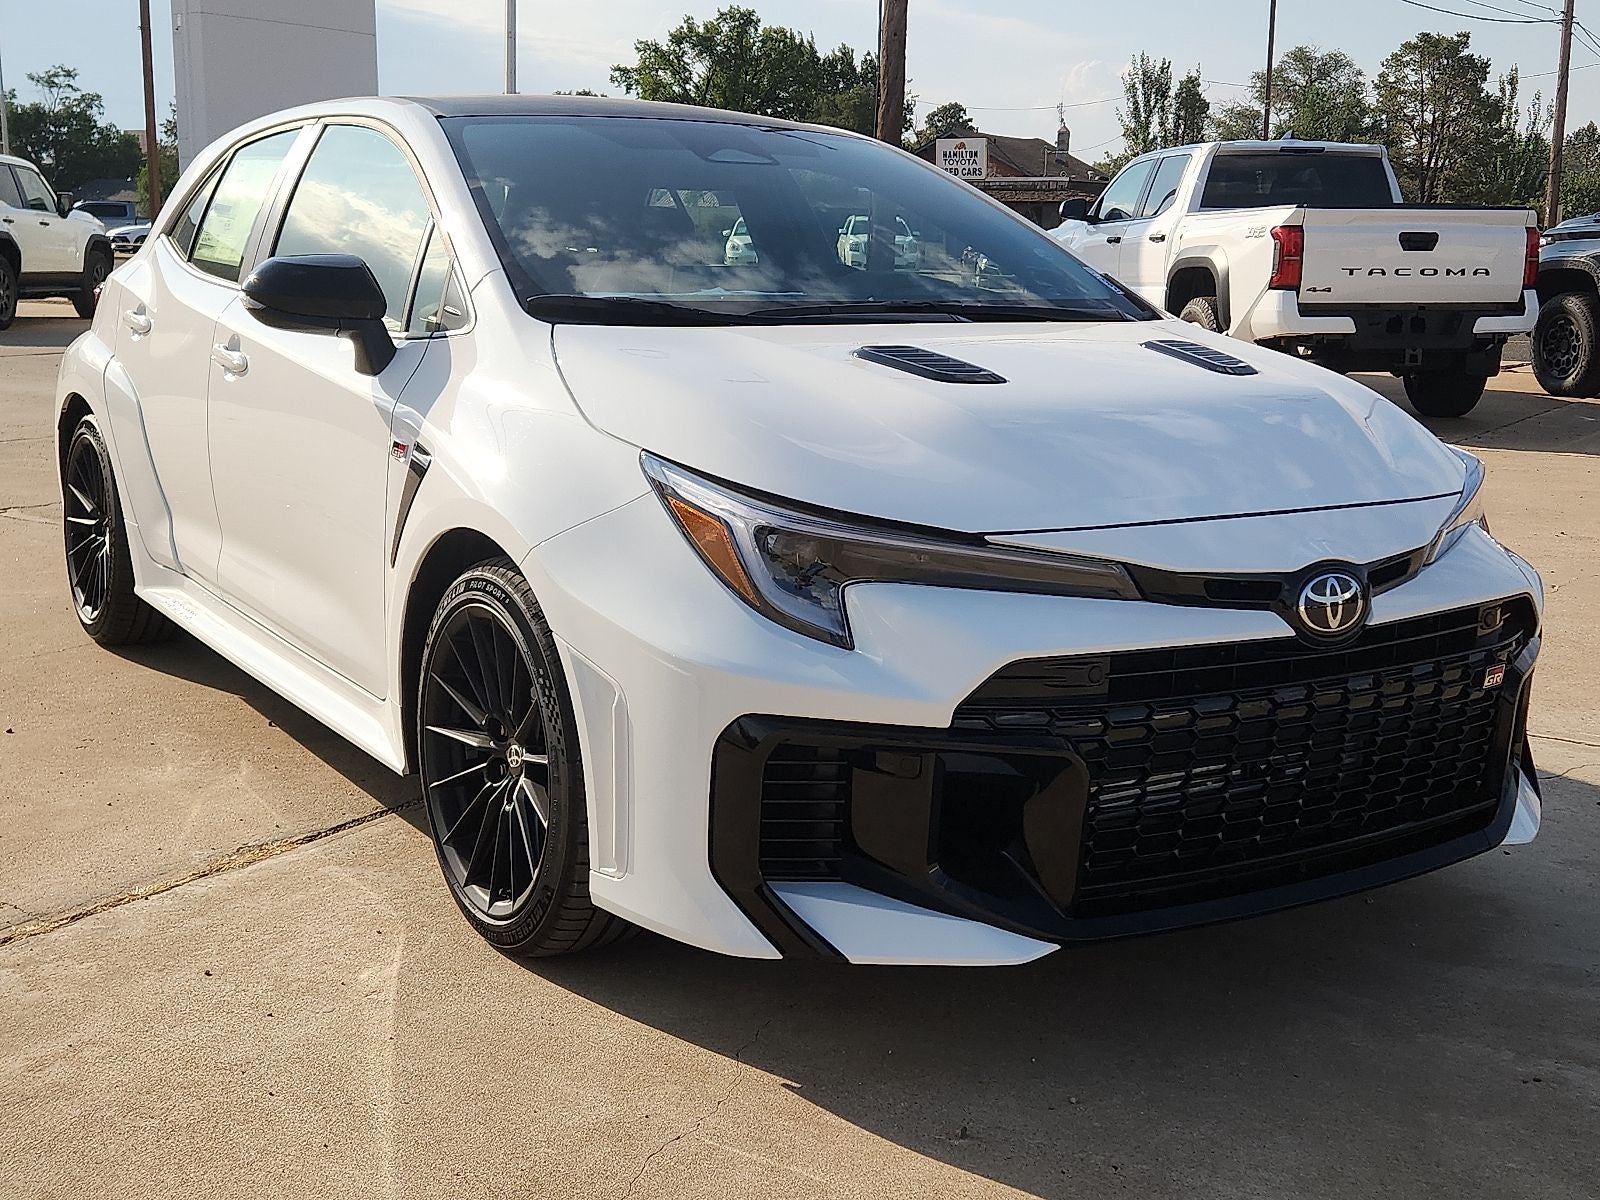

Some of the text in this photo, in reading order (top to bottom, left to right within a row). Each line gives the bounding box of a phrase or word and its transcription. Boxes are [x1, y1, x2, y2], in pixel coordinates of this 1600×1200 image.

[943, 150, 978, 159] HAMILTON
[961, 168, 983, 176] CARS
[1341, 267, 1491, 277] TACOMA
[469, 580, 486, 589] PILOT
[485, 583, 506, 600] SPORT
